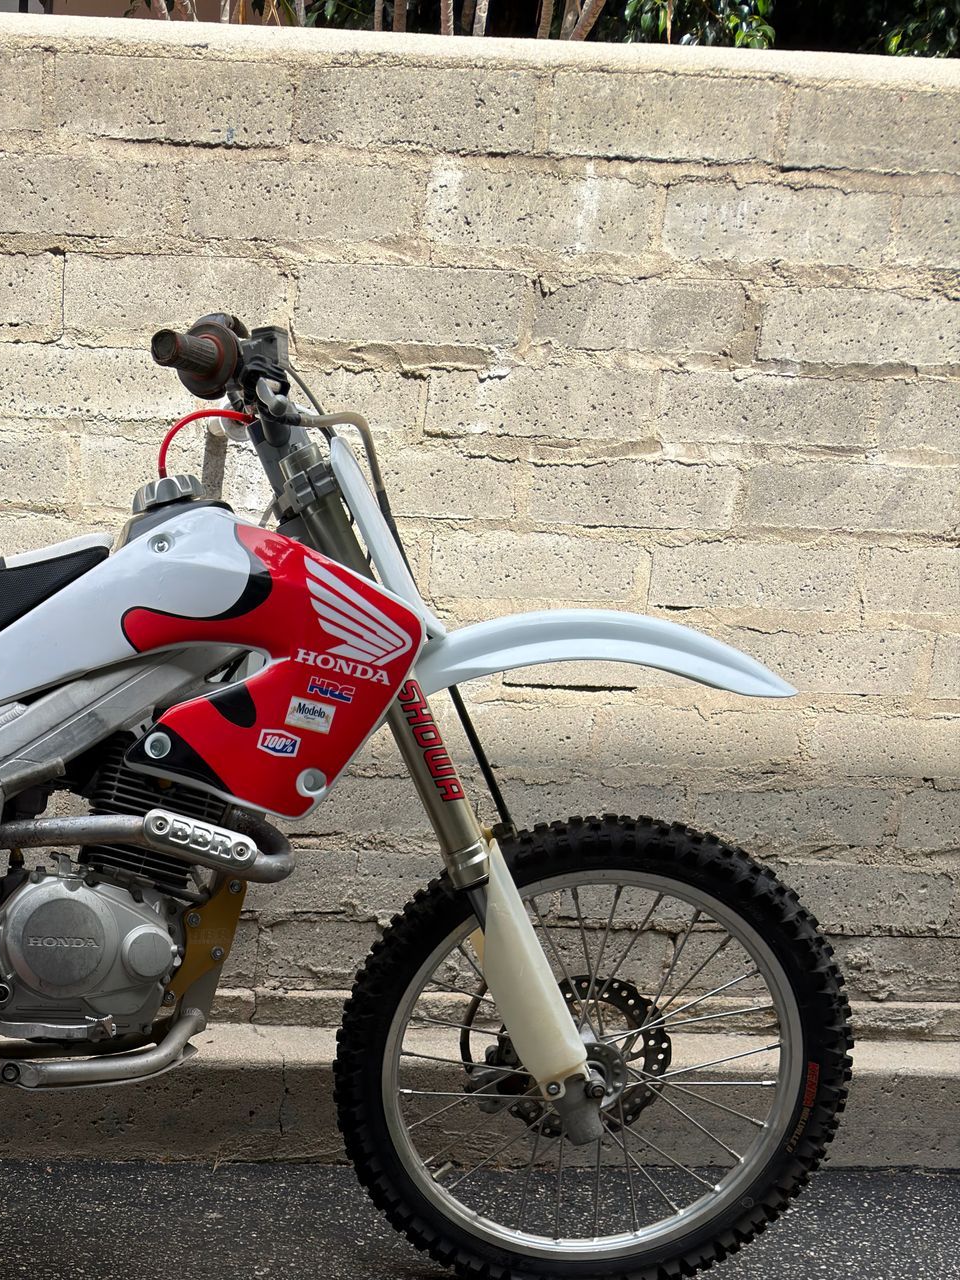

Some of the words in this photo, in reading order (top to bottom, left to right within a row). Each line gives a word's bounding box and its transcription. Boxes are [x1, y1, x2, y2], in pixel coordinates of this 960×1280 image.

[293, 648, 391, 686] HONDA
[307, 676, 356, 704] HRC
[296, 702, 326, 719] Modelo
[263, 733, 296, 753] 100%
[397, 679, 464, 801] SHOWA
[168, 818, 233, 859] BBR
[27, 935, 101, 948] HONDA
